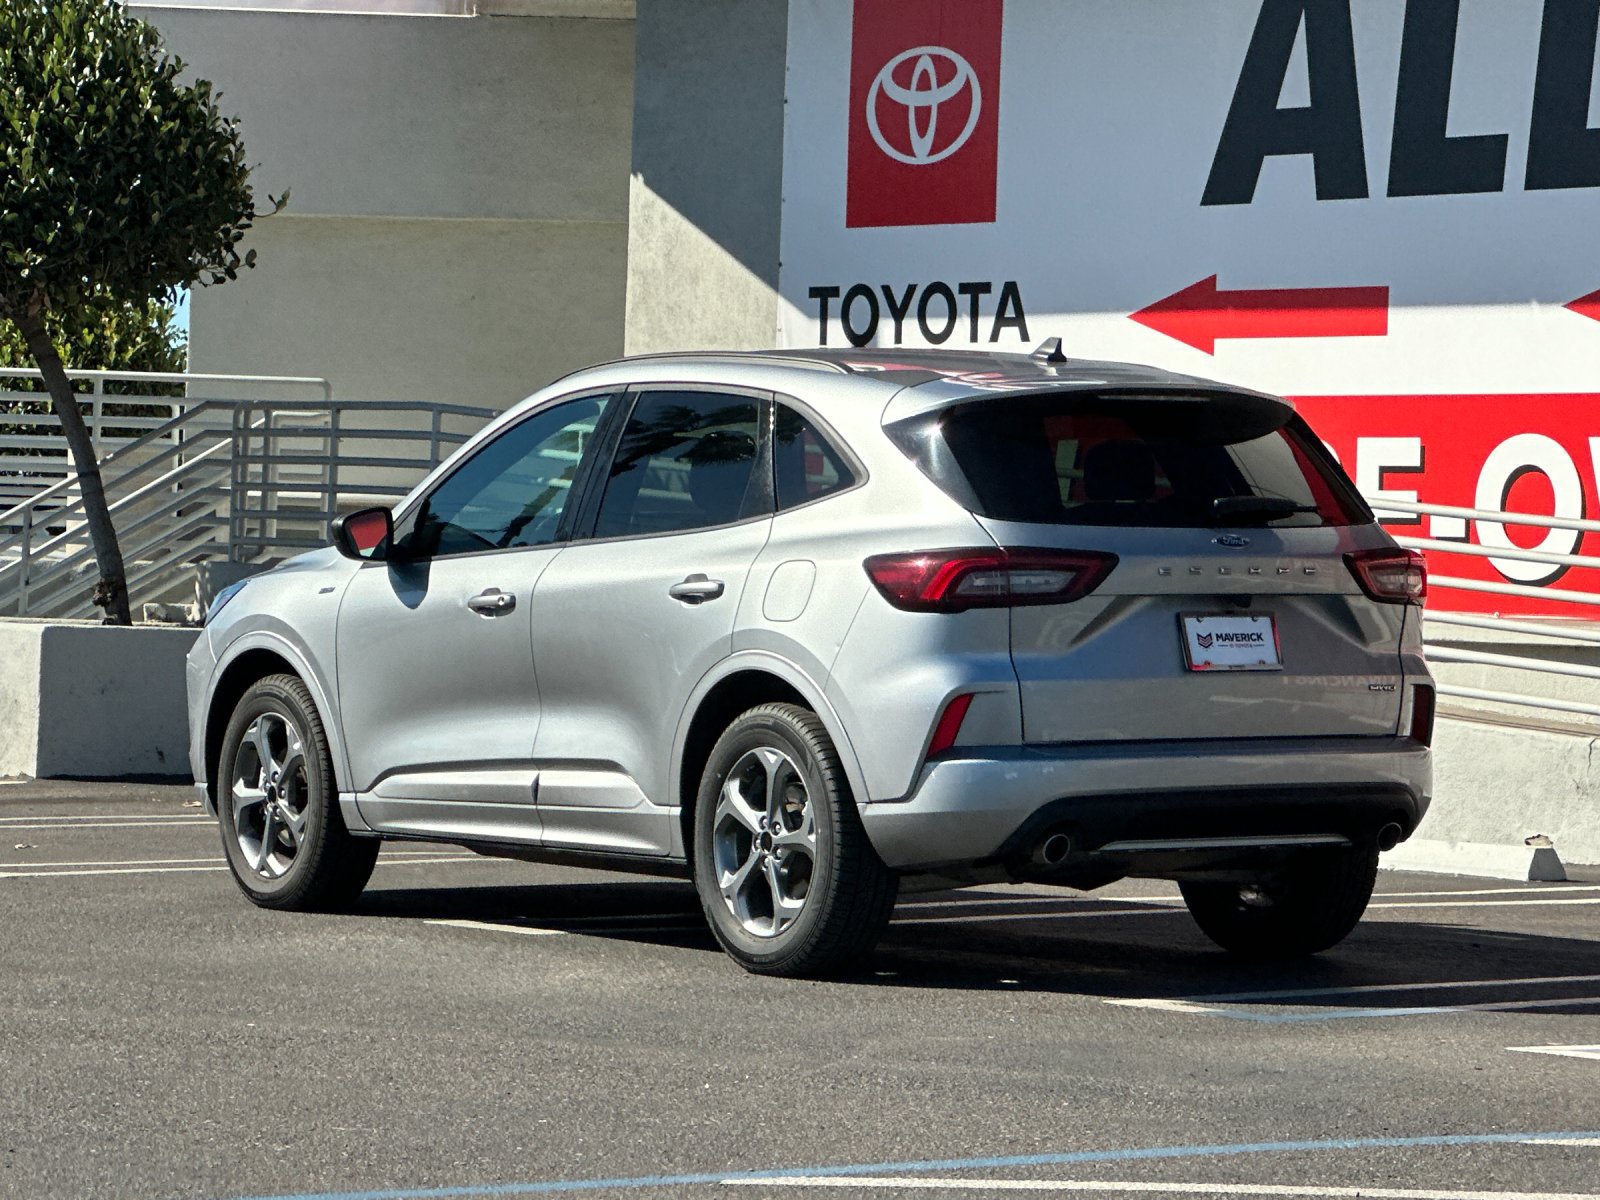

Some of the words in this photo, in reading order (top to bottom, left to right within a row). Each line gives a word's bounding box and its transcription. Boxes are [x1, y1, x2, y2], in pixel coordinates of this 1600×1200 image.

[1200, 0, 1600, 206] ALL
[808, 281, 1030, 347] TOYOTA
[1215, 632, 1265, 642] MAVERICK
